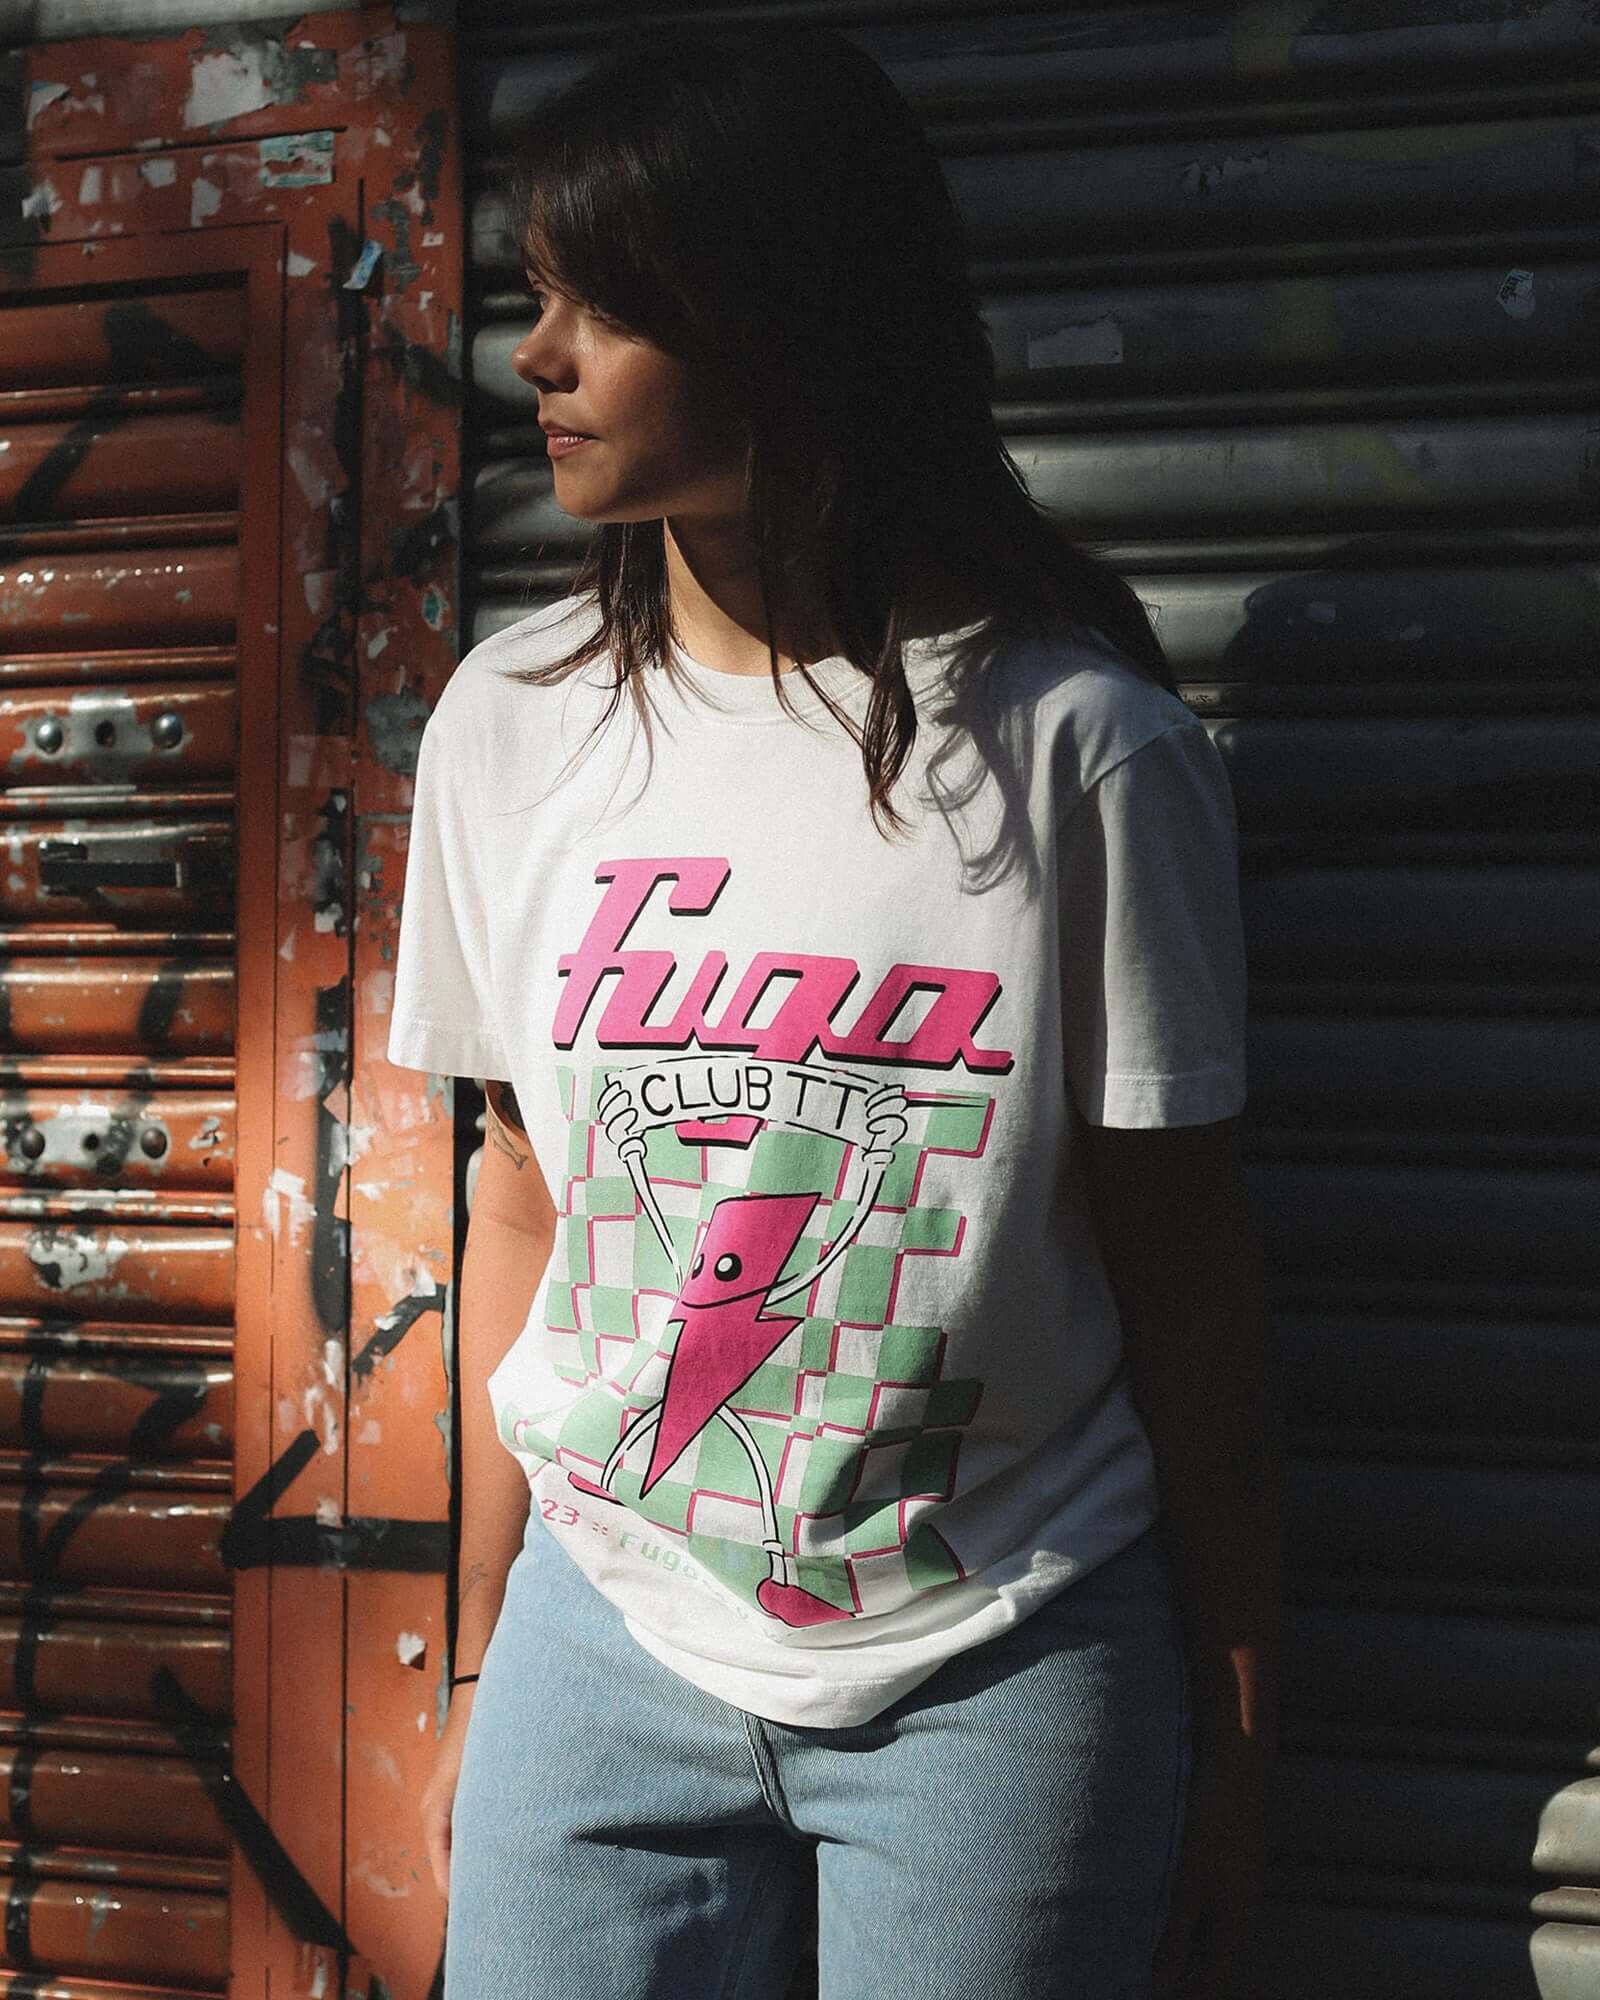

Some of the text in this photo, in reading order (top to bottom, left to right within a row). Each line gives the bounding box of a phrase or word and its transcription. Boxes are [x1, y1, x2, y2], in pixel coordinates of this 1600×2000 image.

[640, 1065, 869, 1130] CLUB TT
[541, 1498, 581, 1527] 23
